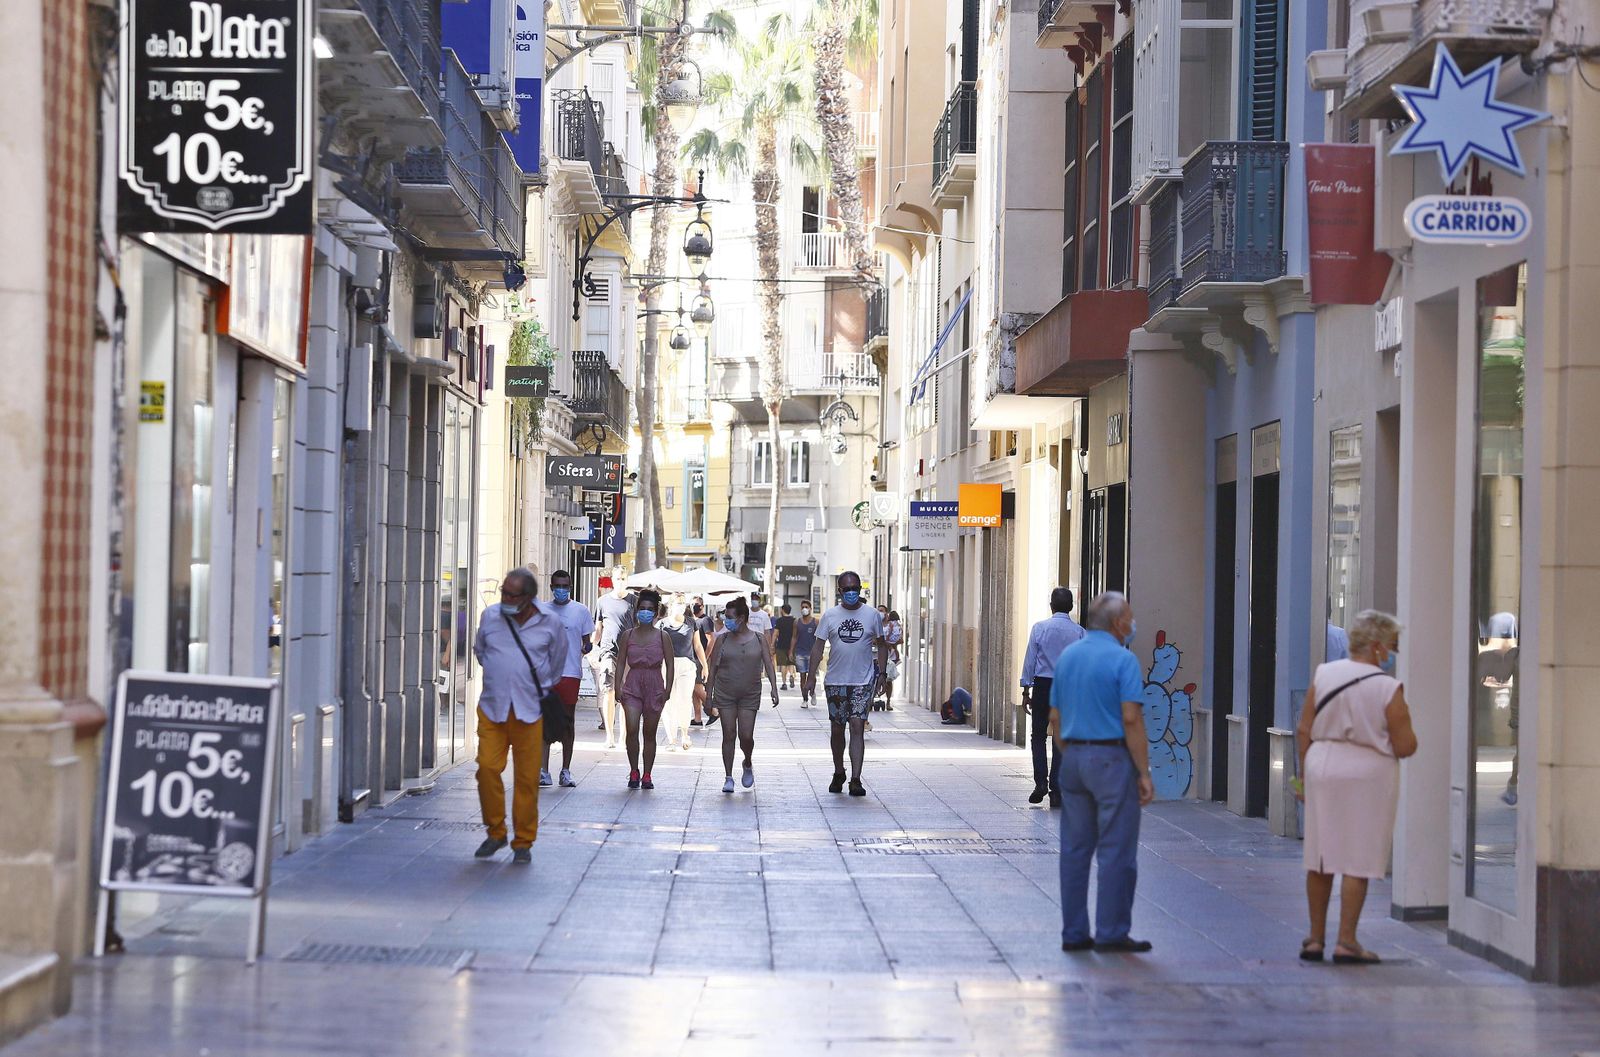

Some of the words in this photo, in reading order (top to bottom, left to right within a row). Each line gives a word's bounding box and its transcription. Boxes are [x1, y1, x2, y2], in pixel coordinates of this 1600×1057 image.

[148, 79, 206, 101] PLATA
[1436, 201, 1502, 212] JUGUETES
[1423, 213, 1516, 232] CARRION
[915, 522, 953, 530] SPENCER
[960, 515, 997, 526] orange
[135, 729, 190, 751] PLATA
